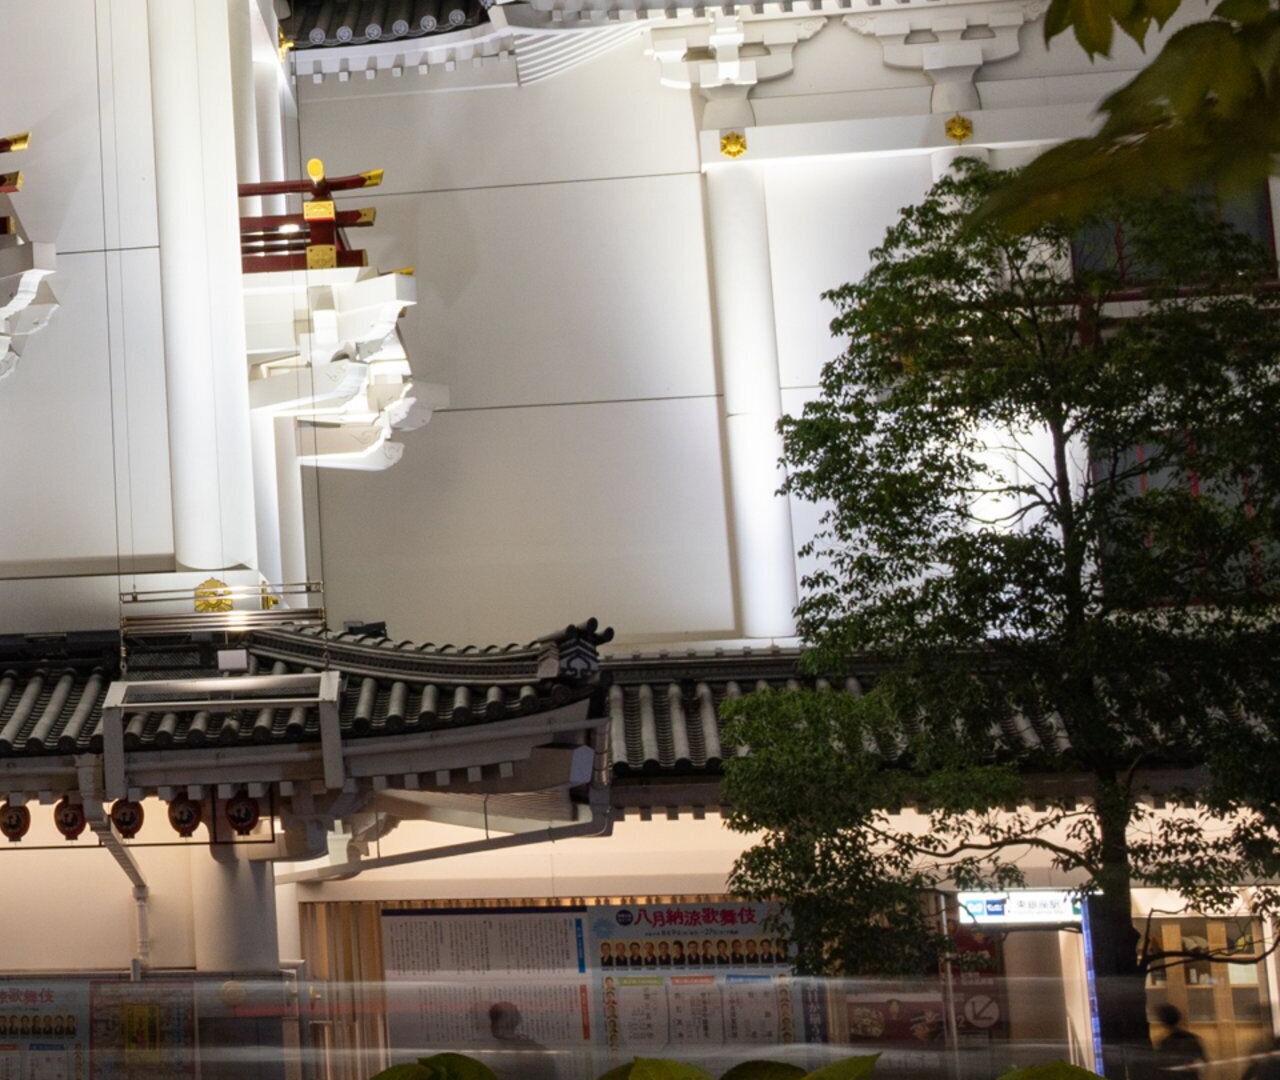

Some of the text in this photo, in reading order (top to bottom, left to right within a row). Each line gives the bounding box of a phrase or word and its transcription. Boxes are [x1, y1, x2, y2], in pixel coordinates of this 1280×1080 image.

[634, 906, 757, 928] 八月納涼歌舞伎
